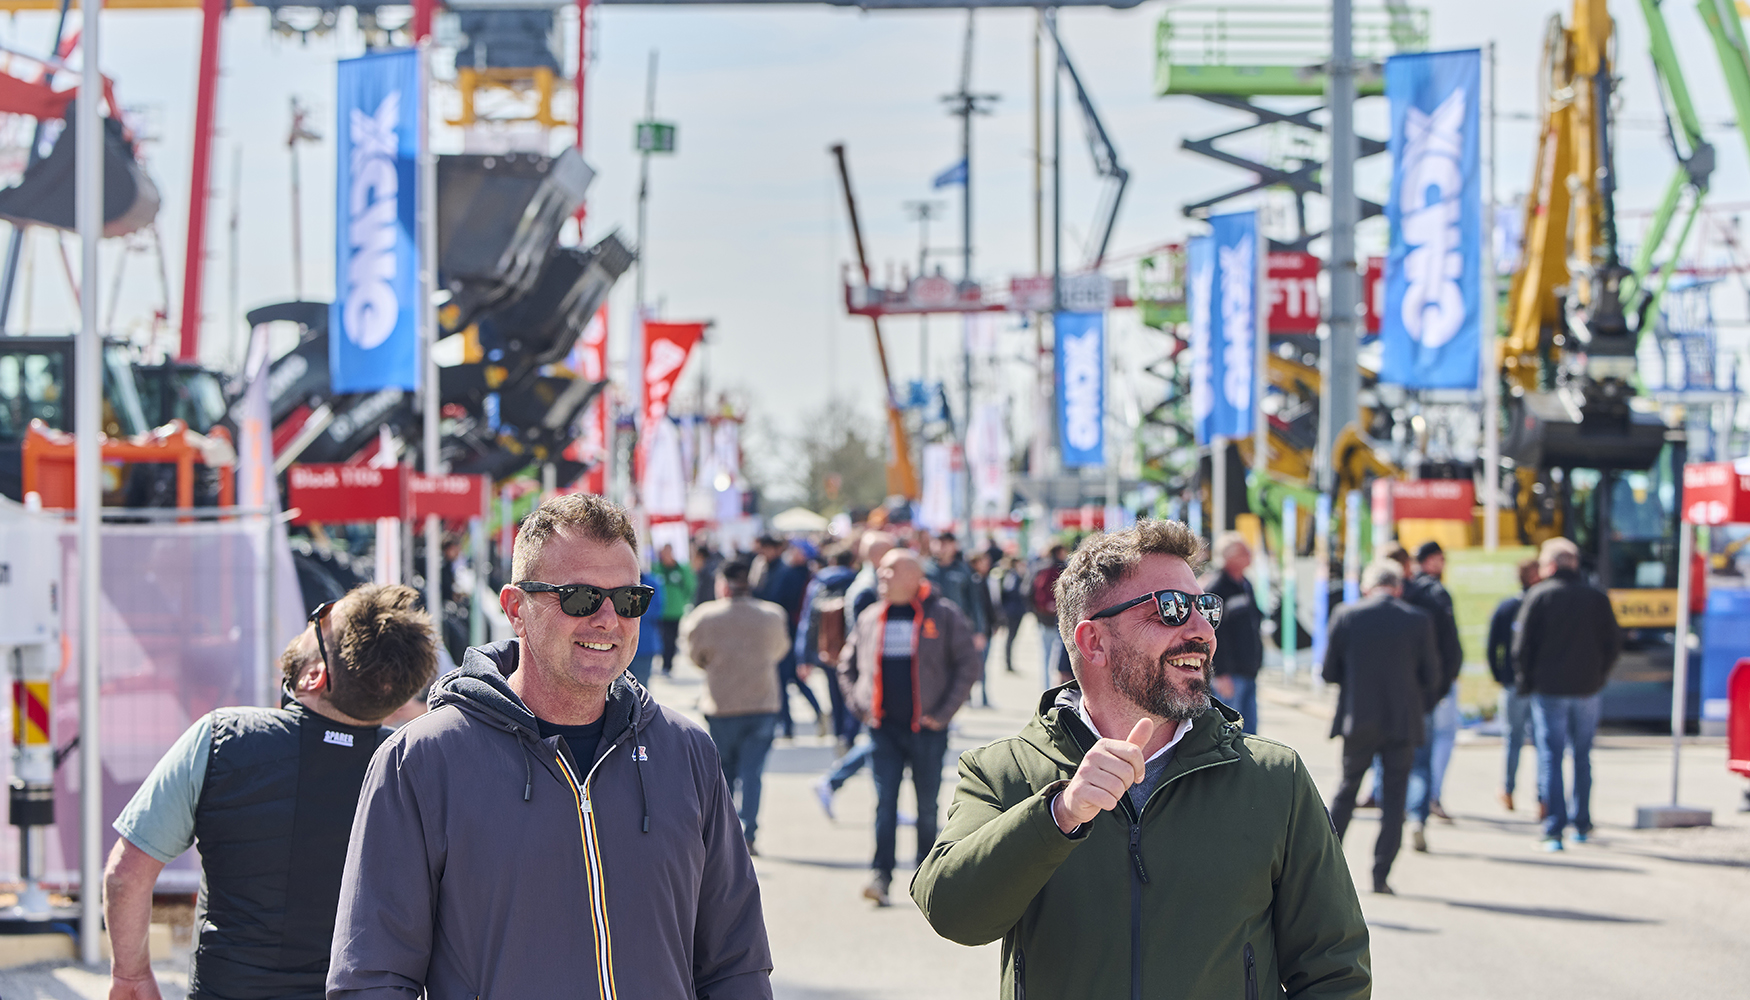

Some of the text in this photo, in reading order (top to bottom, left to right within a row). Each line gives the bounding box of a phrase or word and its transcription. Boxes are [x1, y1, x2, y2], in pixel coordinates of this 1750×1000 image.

[343, 90, 400, 350] XCMG
[1401, 88, 1466, 348] XCMG
[291, 468, 338, 488] Block
